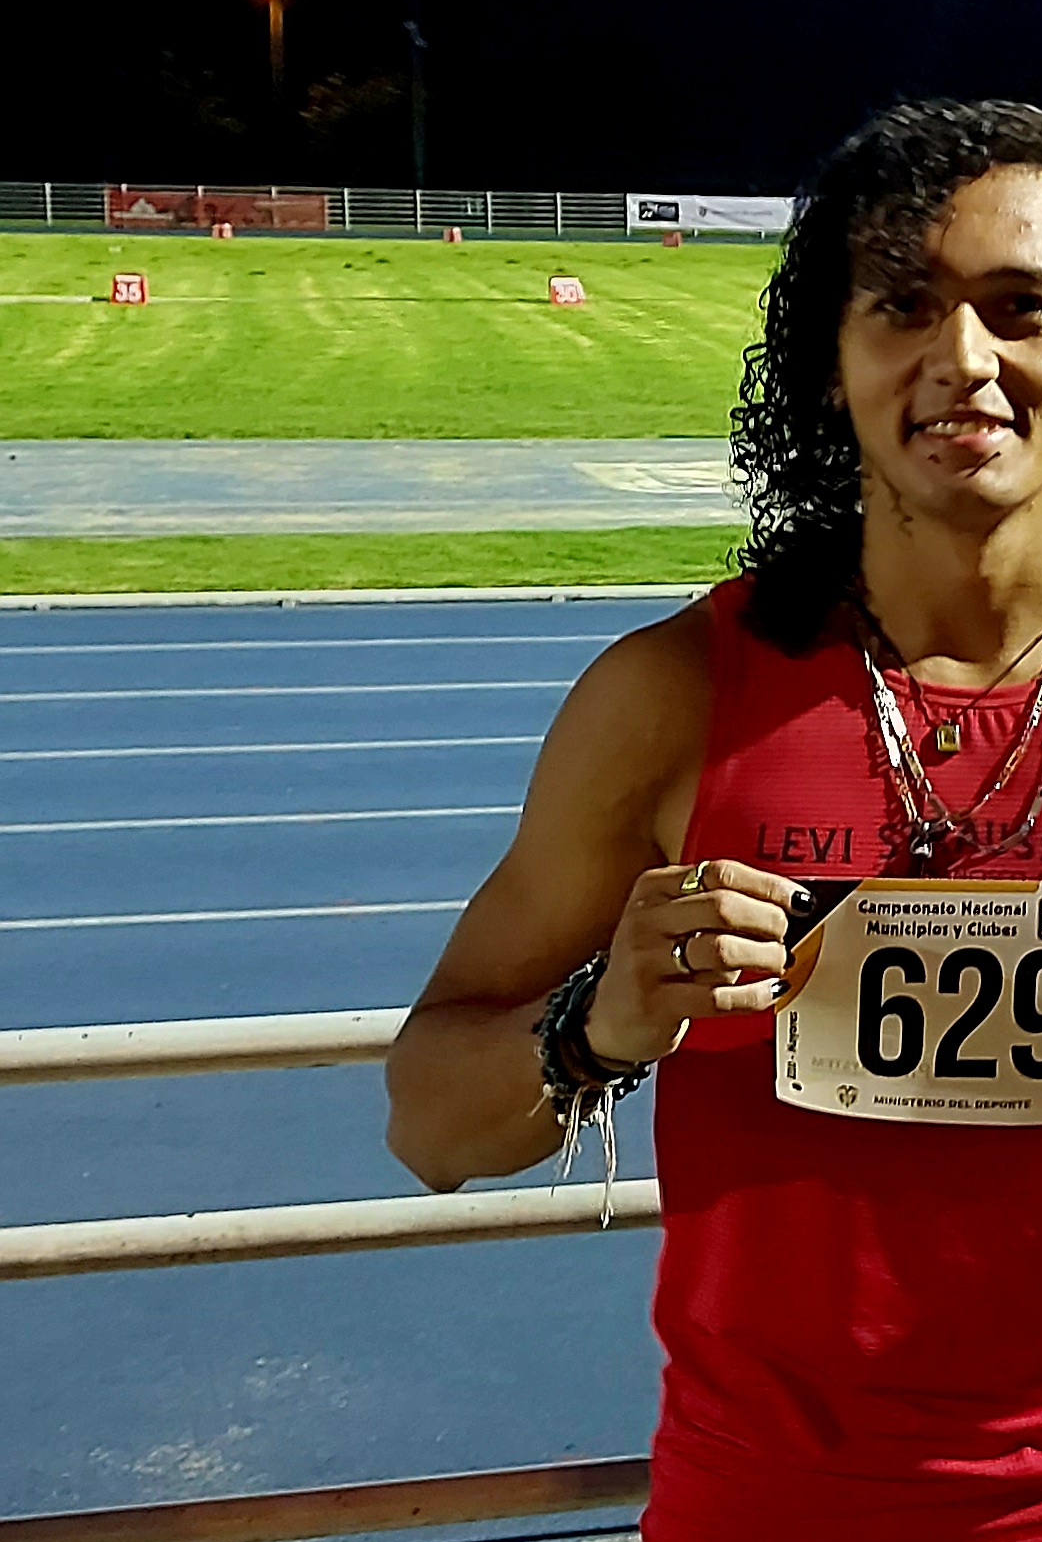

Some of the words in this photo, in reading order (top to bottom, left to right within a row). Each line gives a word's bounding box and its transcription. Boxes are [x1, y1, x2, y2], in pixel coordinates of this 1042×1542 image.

[755, 823, 853, 863] LEVI
[858, 899, 957, 917] Campeonato
[961, 899, 1027, 916] Nacional
[866, 921, 949, 939] Municipios
[953, 923, 962, 939] y
[967, 921, 1018, 937] Clubes
[873, 1095, 945, 1108] MINISTERIO
[948, 1098, 971, 1109] DEL
[974, 1099, 1032, 1110] DEPORTE
